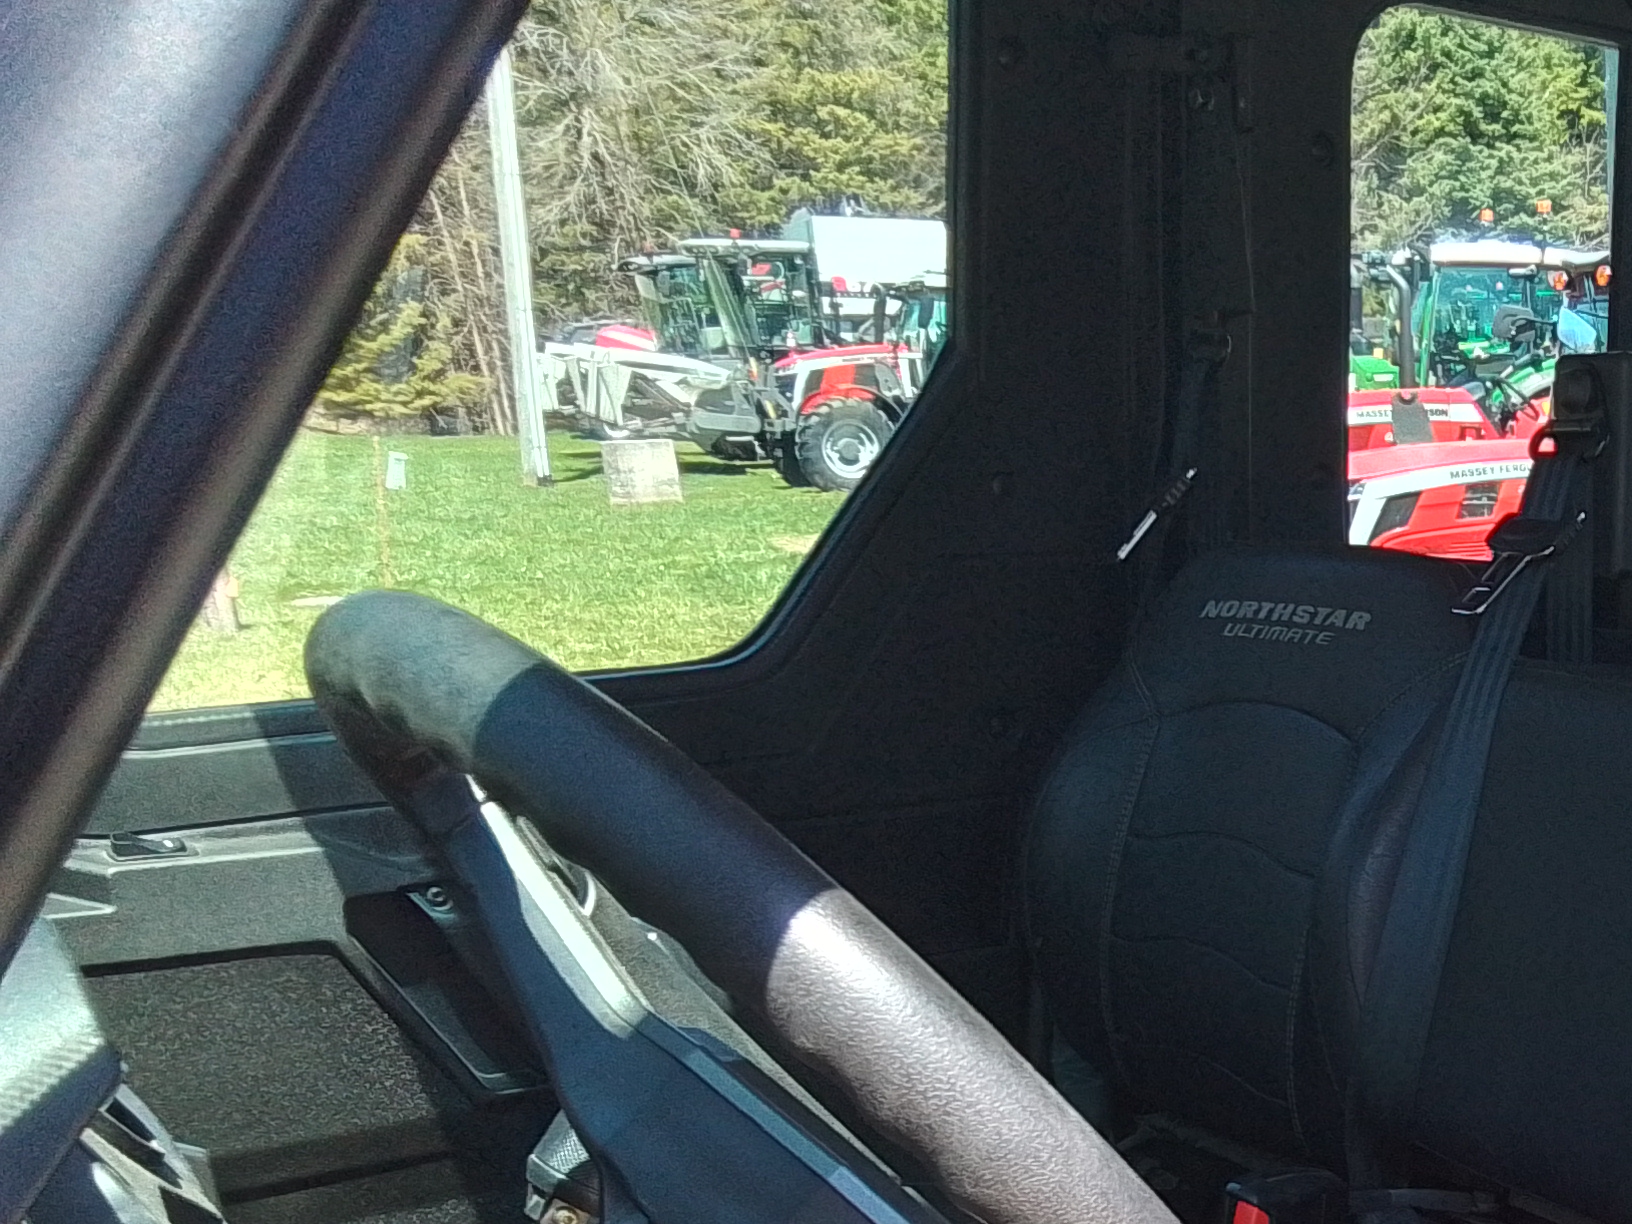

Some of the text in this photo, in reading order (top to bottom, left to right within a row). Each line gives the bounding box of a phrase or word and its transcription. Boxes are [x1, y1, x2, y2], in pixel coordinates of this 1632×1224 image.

[1356, 409, 1393, 418] MASSE
[1450, 467, 1495, 479] MASSEY
[1200, 600, 1372, 631] NORTHSTAR
[1223, 623, 1336, 645] ULTIMATE
